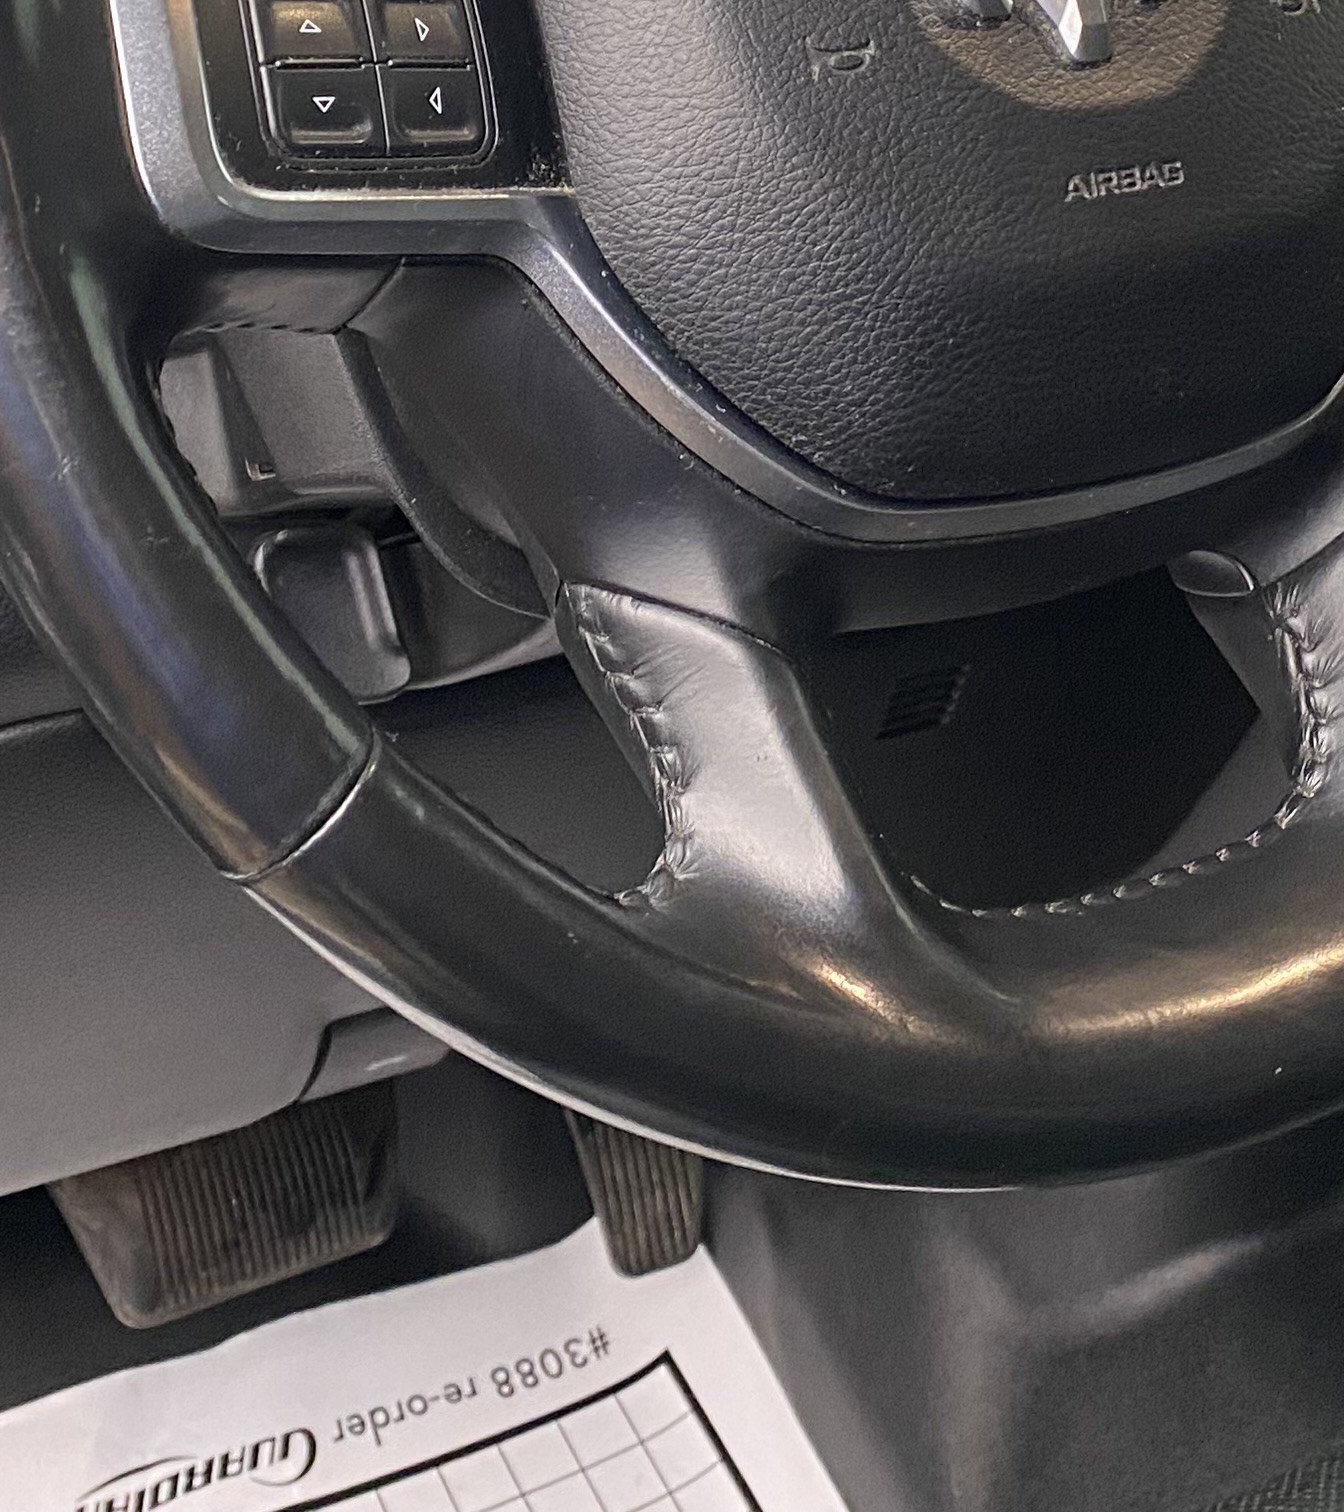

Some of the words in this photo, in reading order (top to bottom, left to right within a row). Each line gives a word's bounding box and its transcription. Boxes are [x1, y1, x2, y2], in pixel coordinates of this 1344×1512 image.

[1064, 160, 1186, 202] AIRBAG
[491, 1325, 611, 1399] #3088
[332, 1377, 479, 1447] re-order
